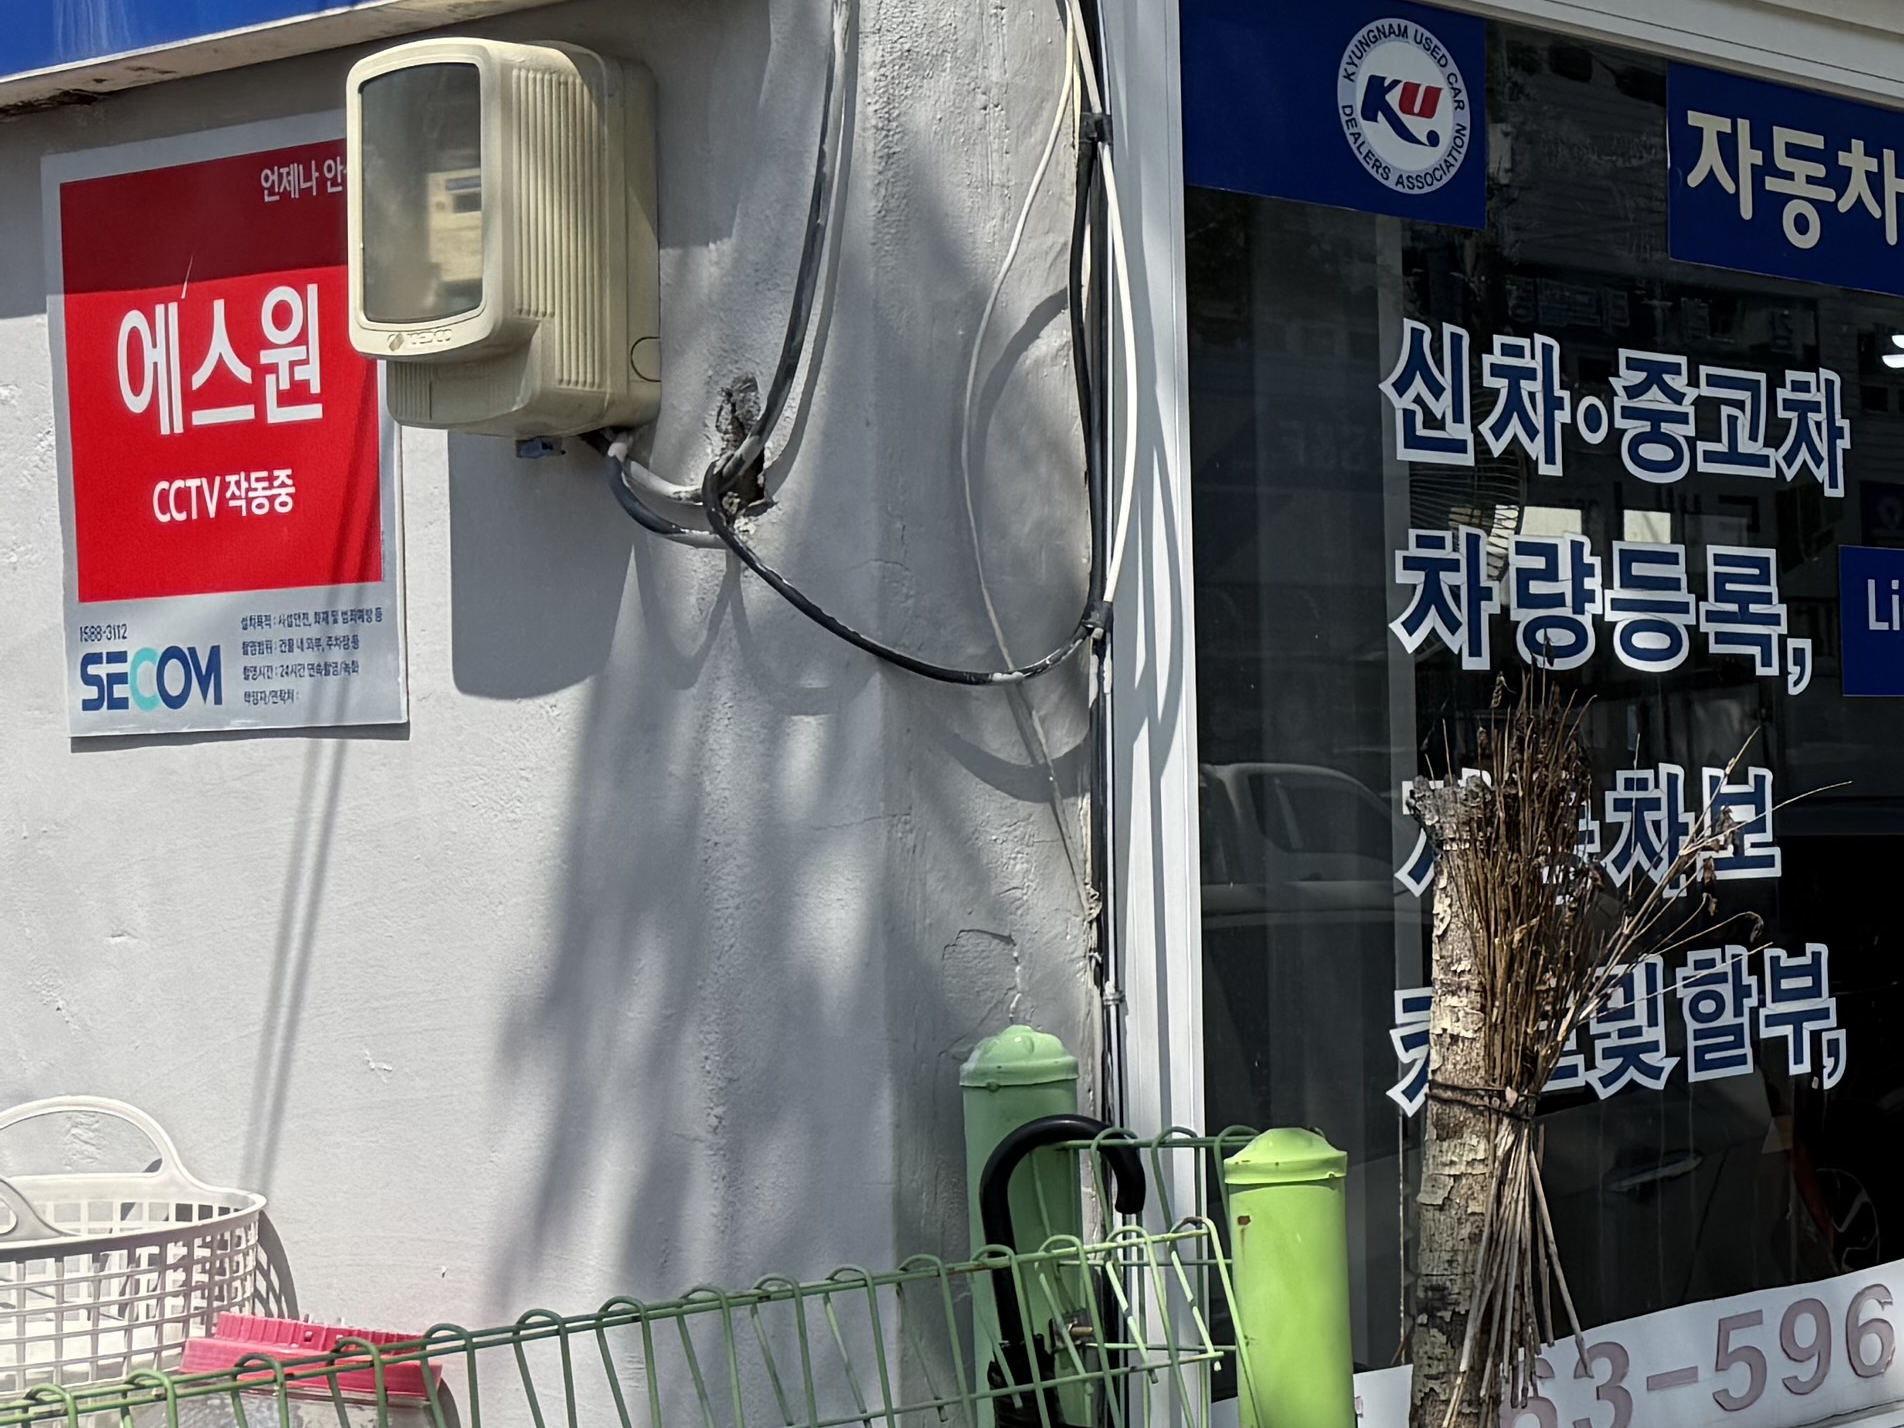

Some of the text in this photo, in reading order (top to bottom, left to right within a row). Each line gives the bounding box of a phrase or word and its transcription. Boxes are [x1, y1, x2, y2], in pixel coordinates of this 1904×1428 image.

[1343, 23, 1465, 111] KYUNGNAM USED CAR
[261, 156, 347, 202] 언제나 안
[1342, 104, 1467, 190] DEALERS ASSOCIATION
[116, 283, 322, 435] 에스원
[152, 469, 296, 523] CCTV 작동중
[80, 624, 127, 643] 1588-3112
[1389, 525, 1812, 695] 차량등록,
[80, 645, 223, 712] SECOM
